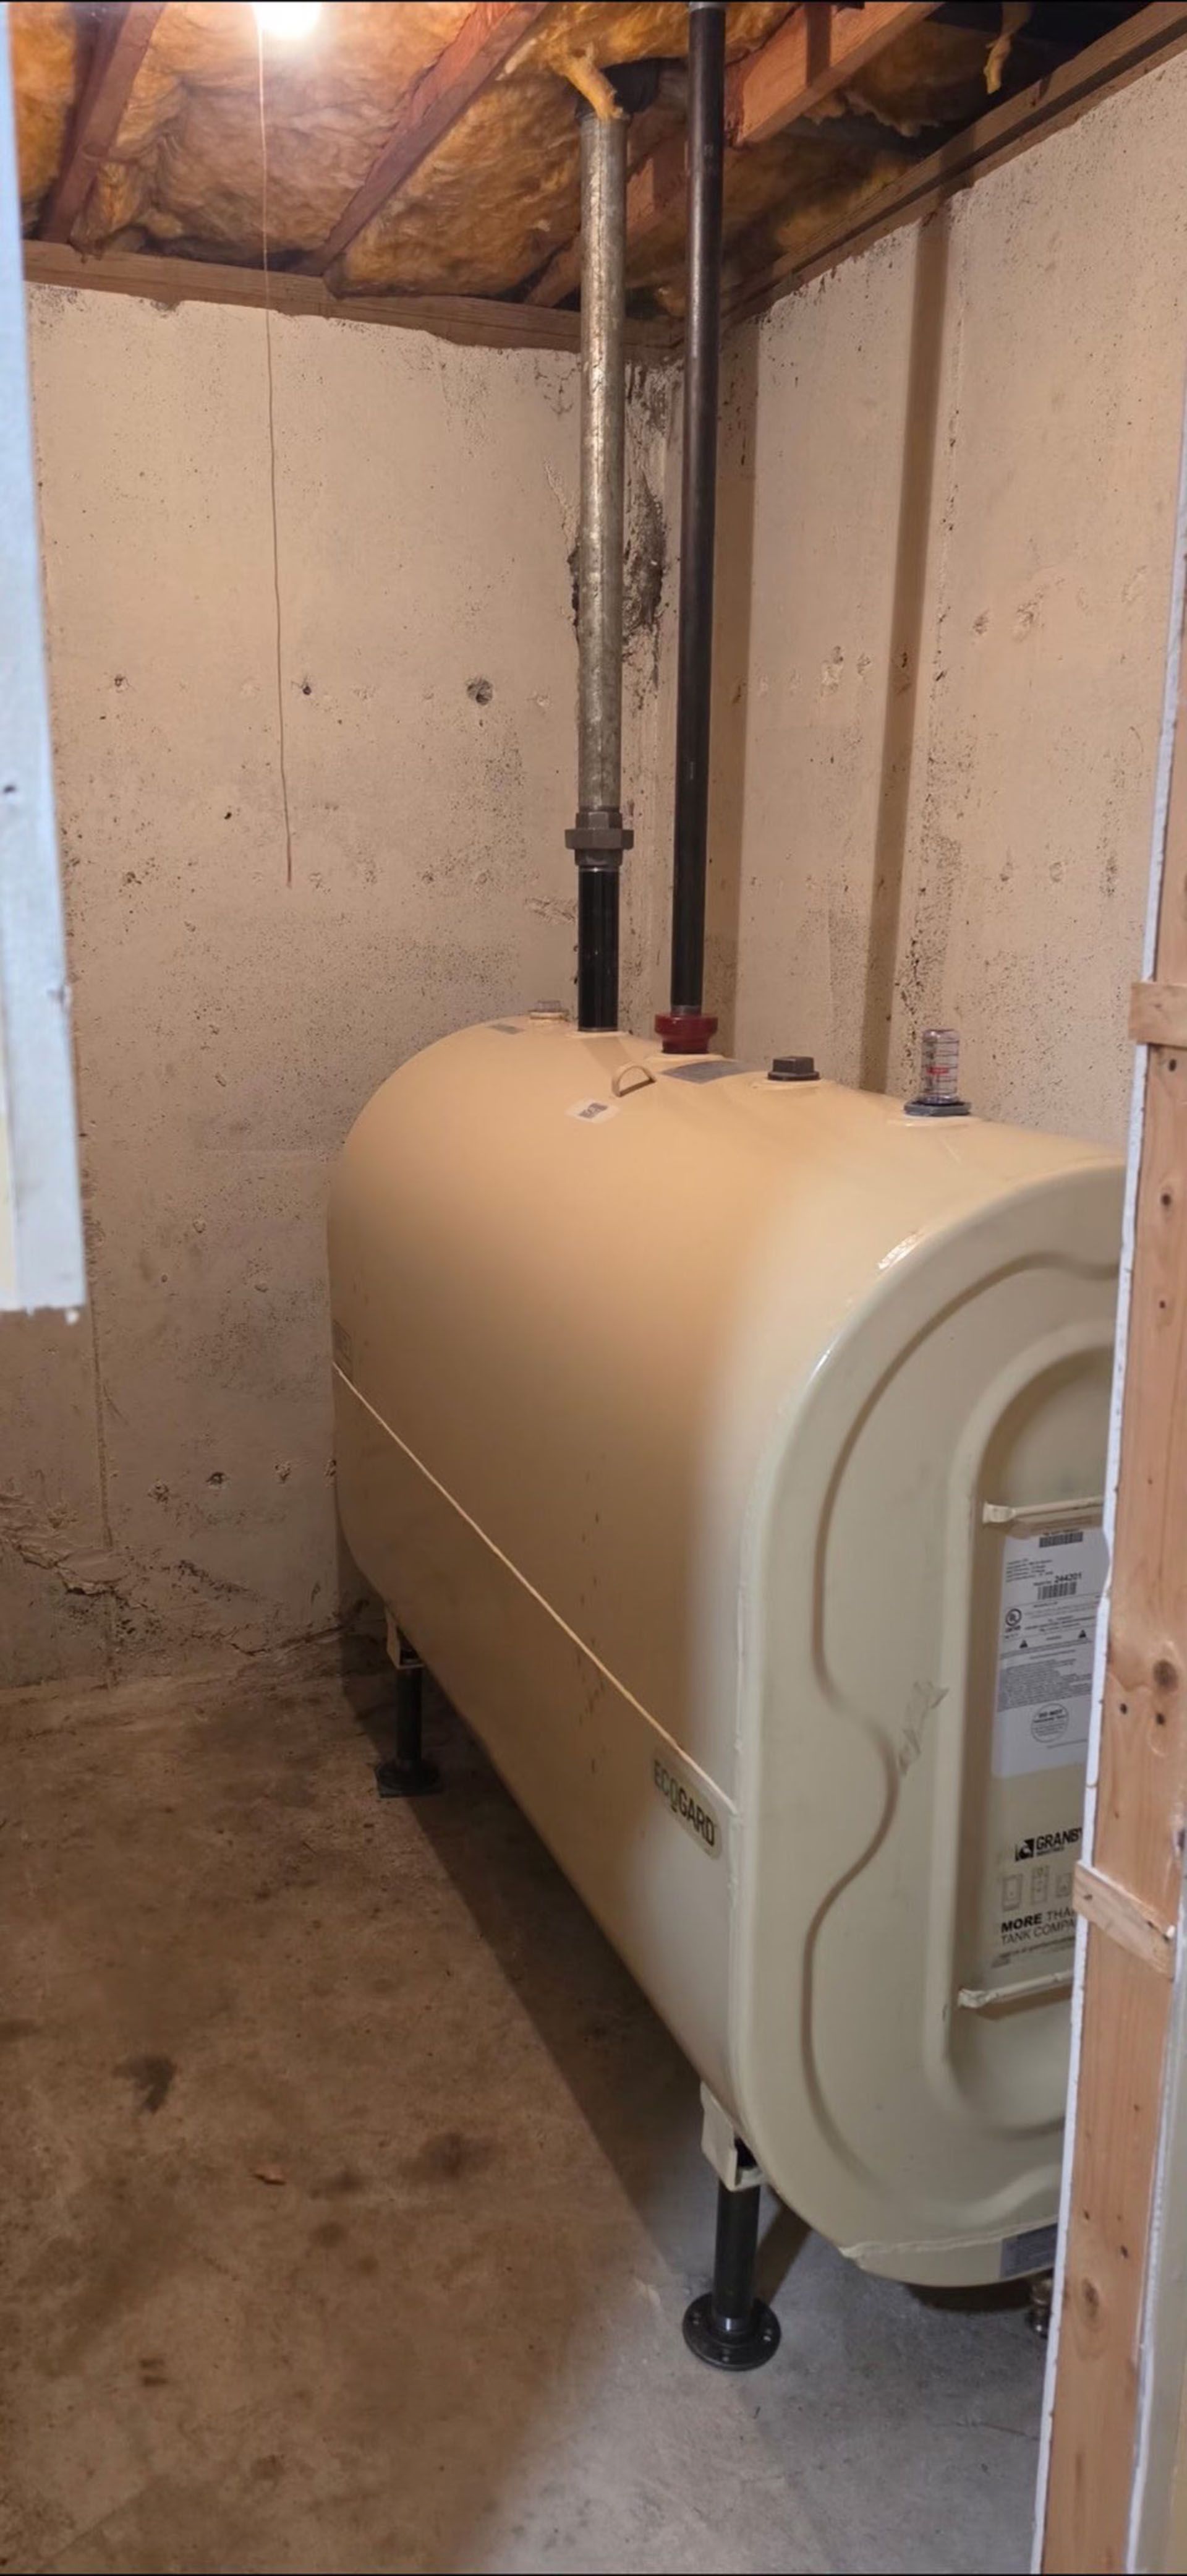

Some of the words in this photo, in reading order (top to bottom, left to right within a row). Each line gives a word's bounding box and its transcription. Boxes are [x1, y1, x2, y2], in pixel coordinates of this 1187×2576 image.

[653, 1759, 715, 1847] ECOGARD
[1001, 1912, 1043, 1933] MORE
[1002, 1930, 1031, 1945] TANK
